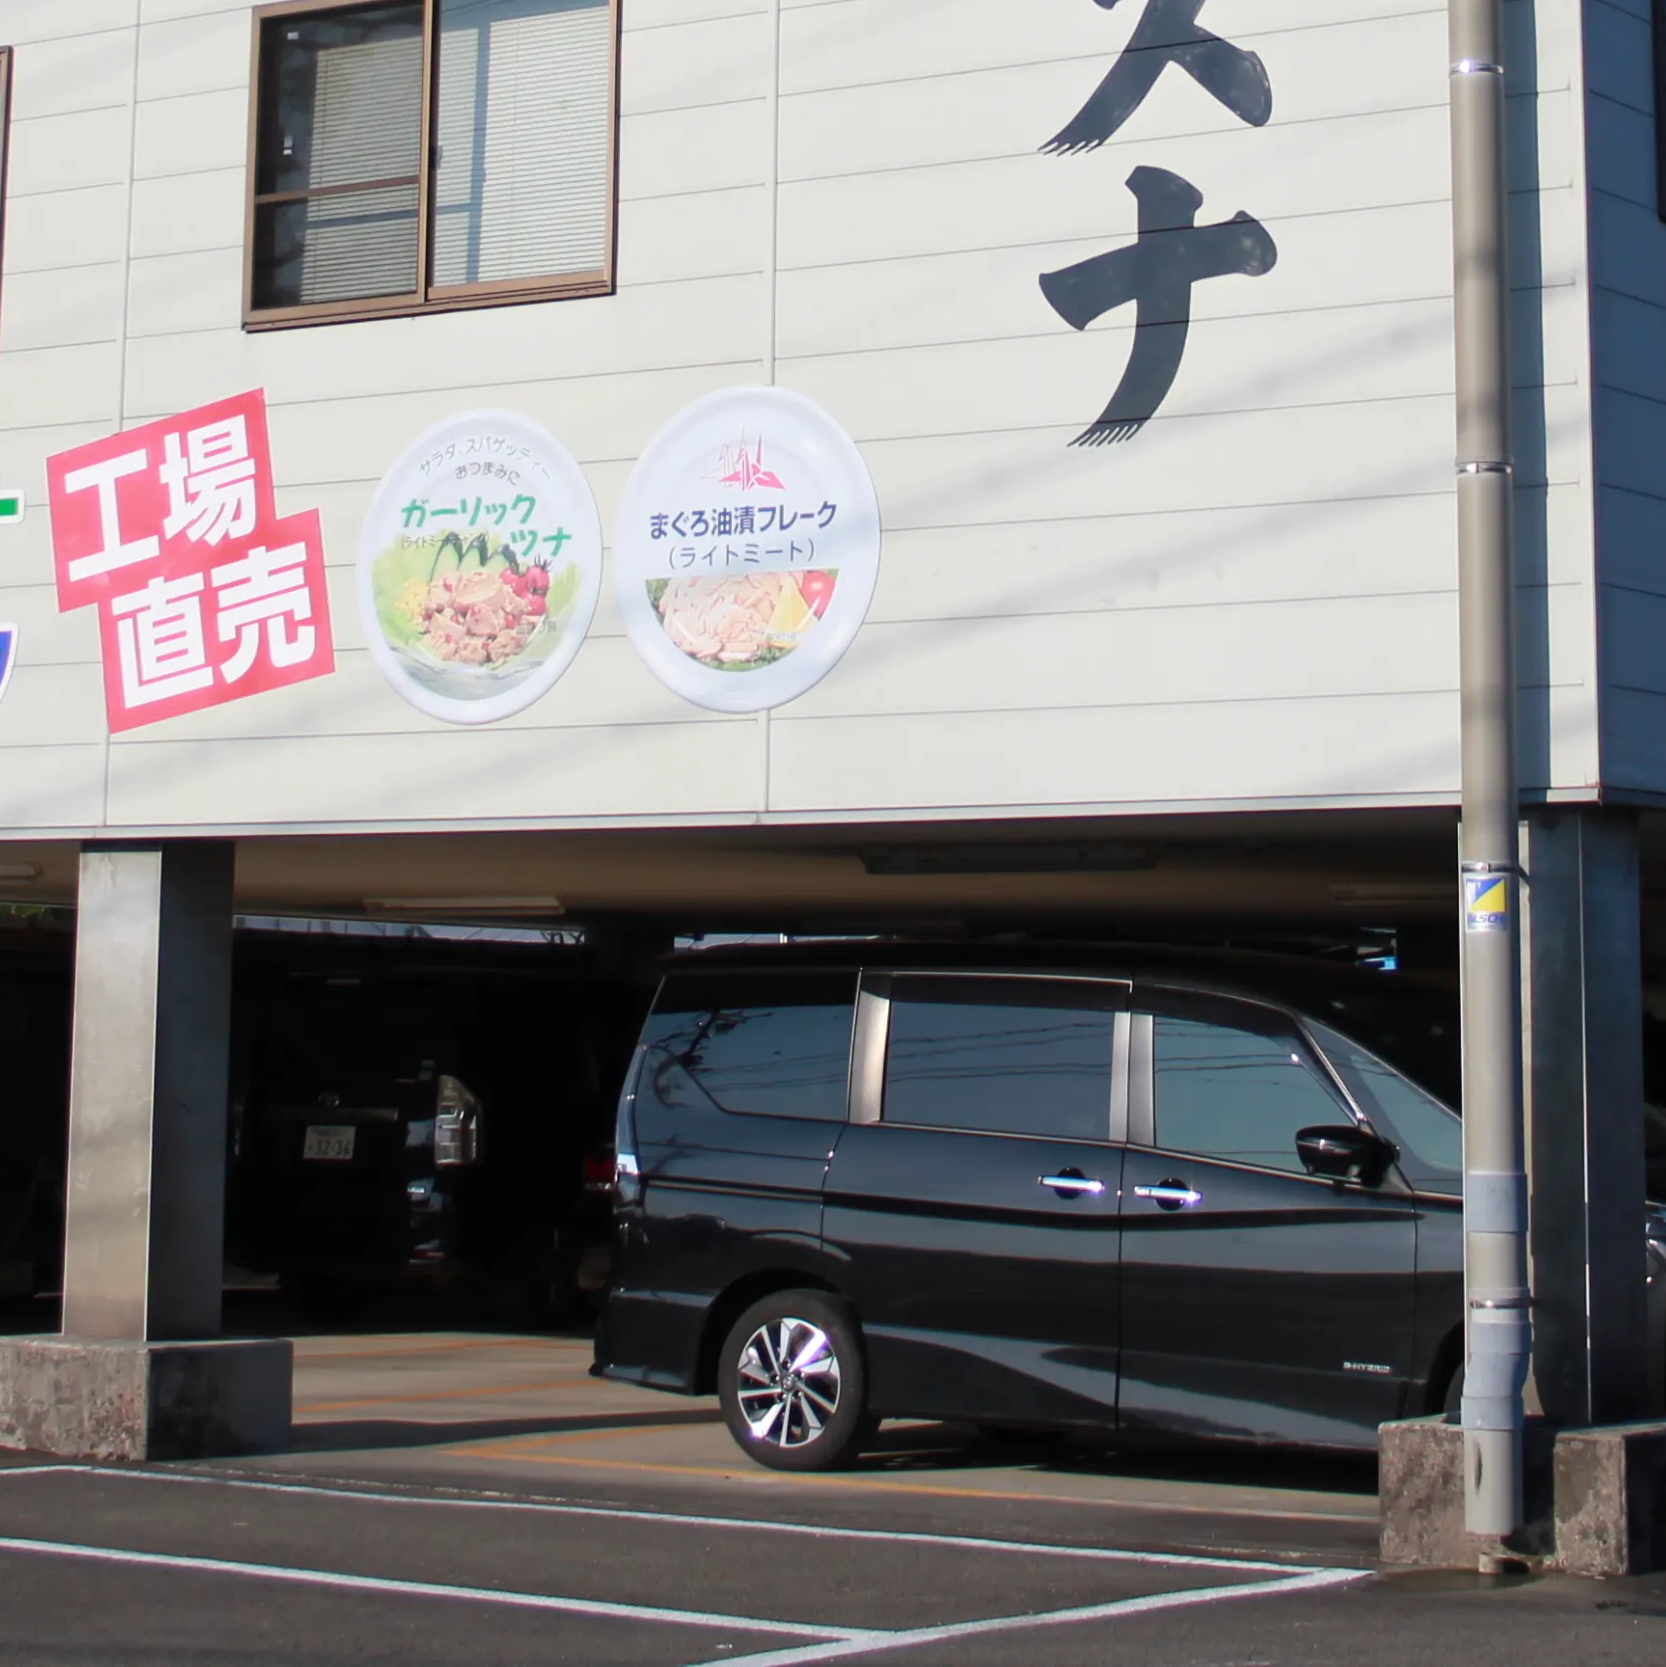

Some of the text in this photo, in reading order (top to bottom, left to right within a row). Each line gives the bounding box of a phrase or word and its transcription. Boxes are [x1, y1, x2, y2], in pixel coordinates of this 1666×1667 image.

[64, 413, 255, 582] 工場
[401, 494, 537, 529] ガーリック
[650, 500, 838, 540] まぐろ油漬フレーク
[510, 527, 572, 557] ツナ
[109, 542, 316, 713] 直売
